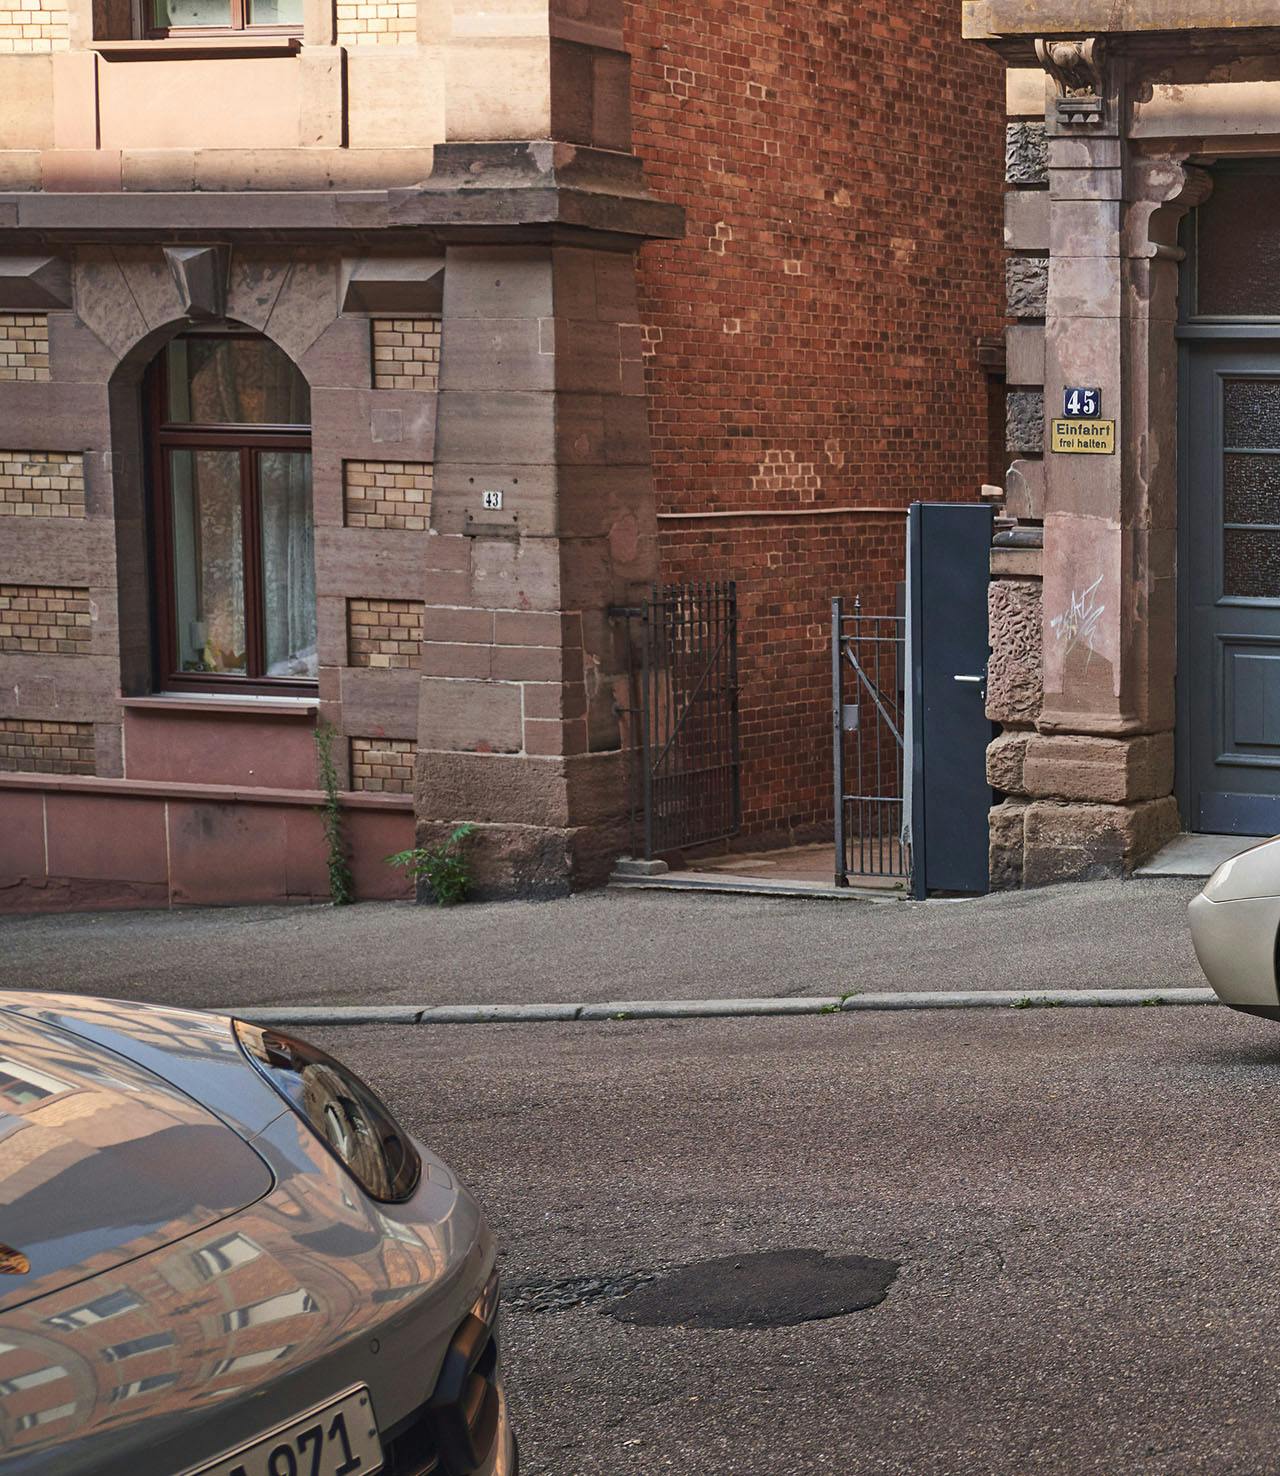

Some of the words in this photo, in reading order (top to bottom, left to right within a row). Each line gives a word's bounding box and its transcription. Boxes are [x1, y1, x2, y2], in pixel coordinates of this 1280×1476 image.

[1067, 390, 1095, 414] 45
[1056, 423, 1110, 436] Einfahrt
[1059, 438, 1074, 448] frei
[1077, 438, 1107, 449] halten
[485, 493, 499, 507] 43
